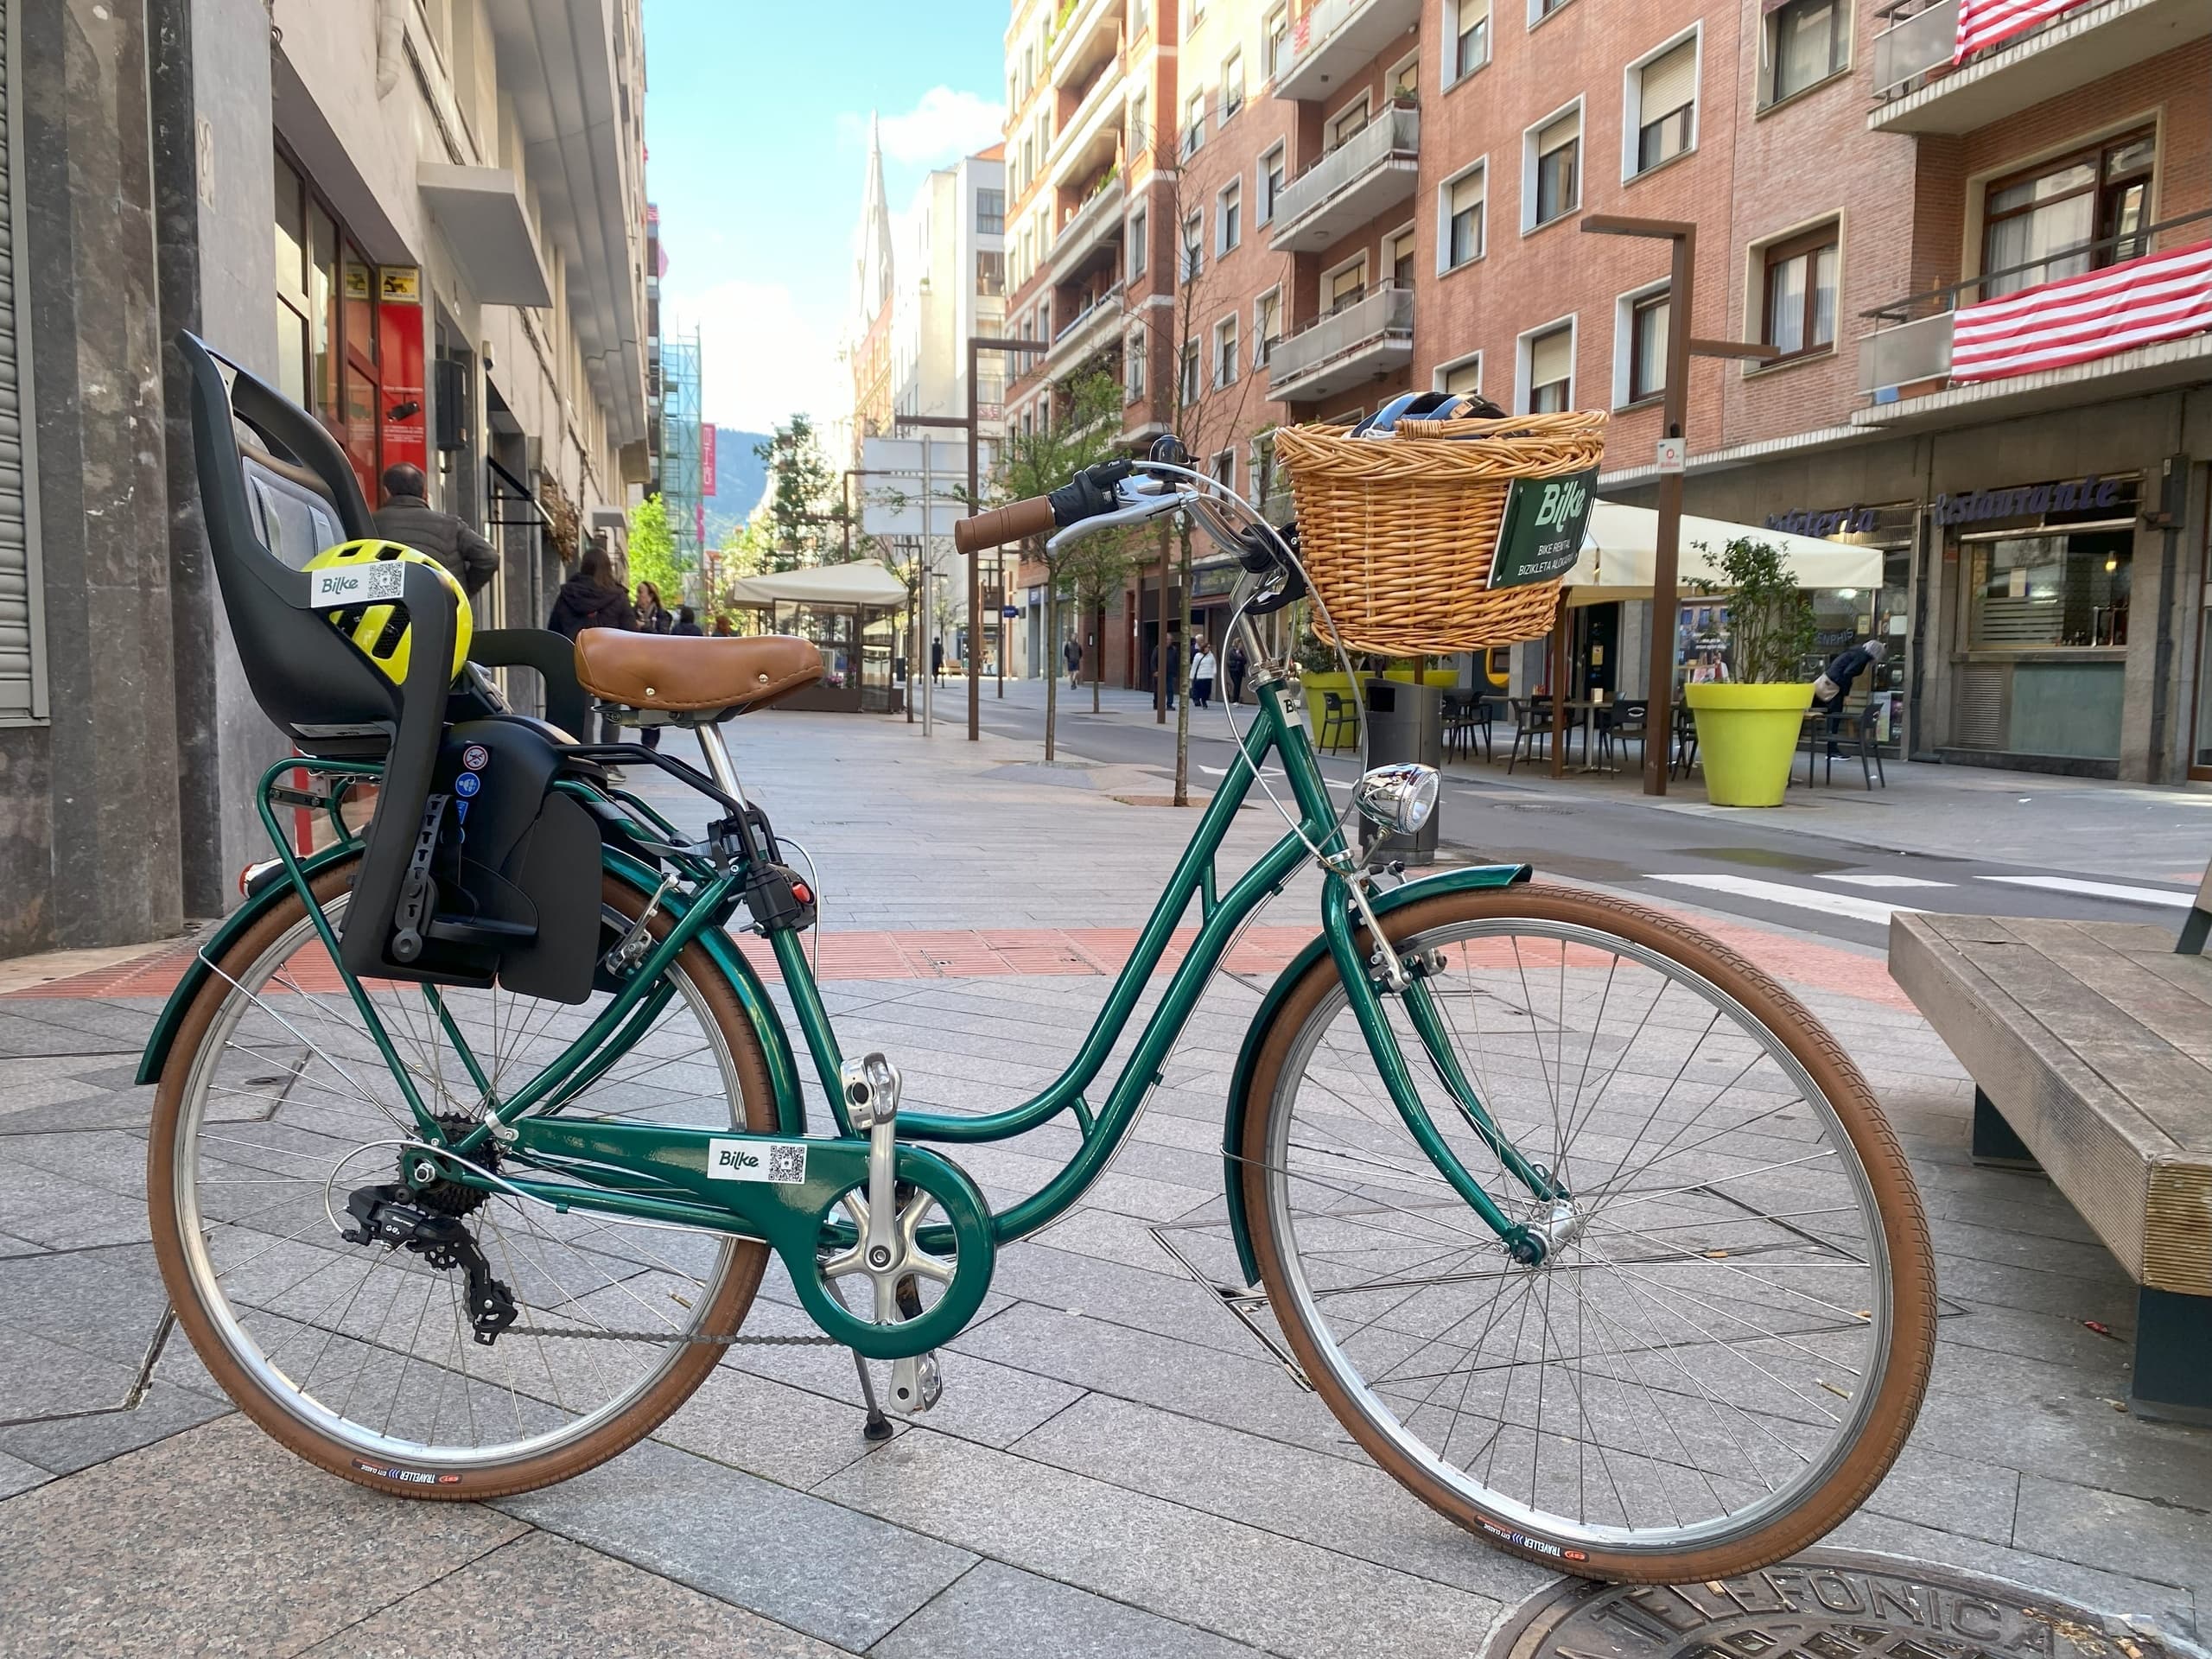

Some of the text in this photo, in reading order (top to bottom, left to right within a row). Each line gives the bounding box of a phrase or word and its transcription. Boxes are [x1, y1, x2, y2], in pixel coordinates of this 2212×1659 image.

[1535, 480, 1586, 533] Bilke
[1933, 475, 2122, 525] Restaurante
[1538, 543, 1553, 556] BIKE
[1518, 561, 1551, 575] BIZIKLETA
[321, 576, 359, 594] Bilke
[719, 1150, 760, 1170] Bilke
[400, 1470, 435, 1483] TRAVELLER
[1523, 1536, 1560, 1556] TRAVELLER
